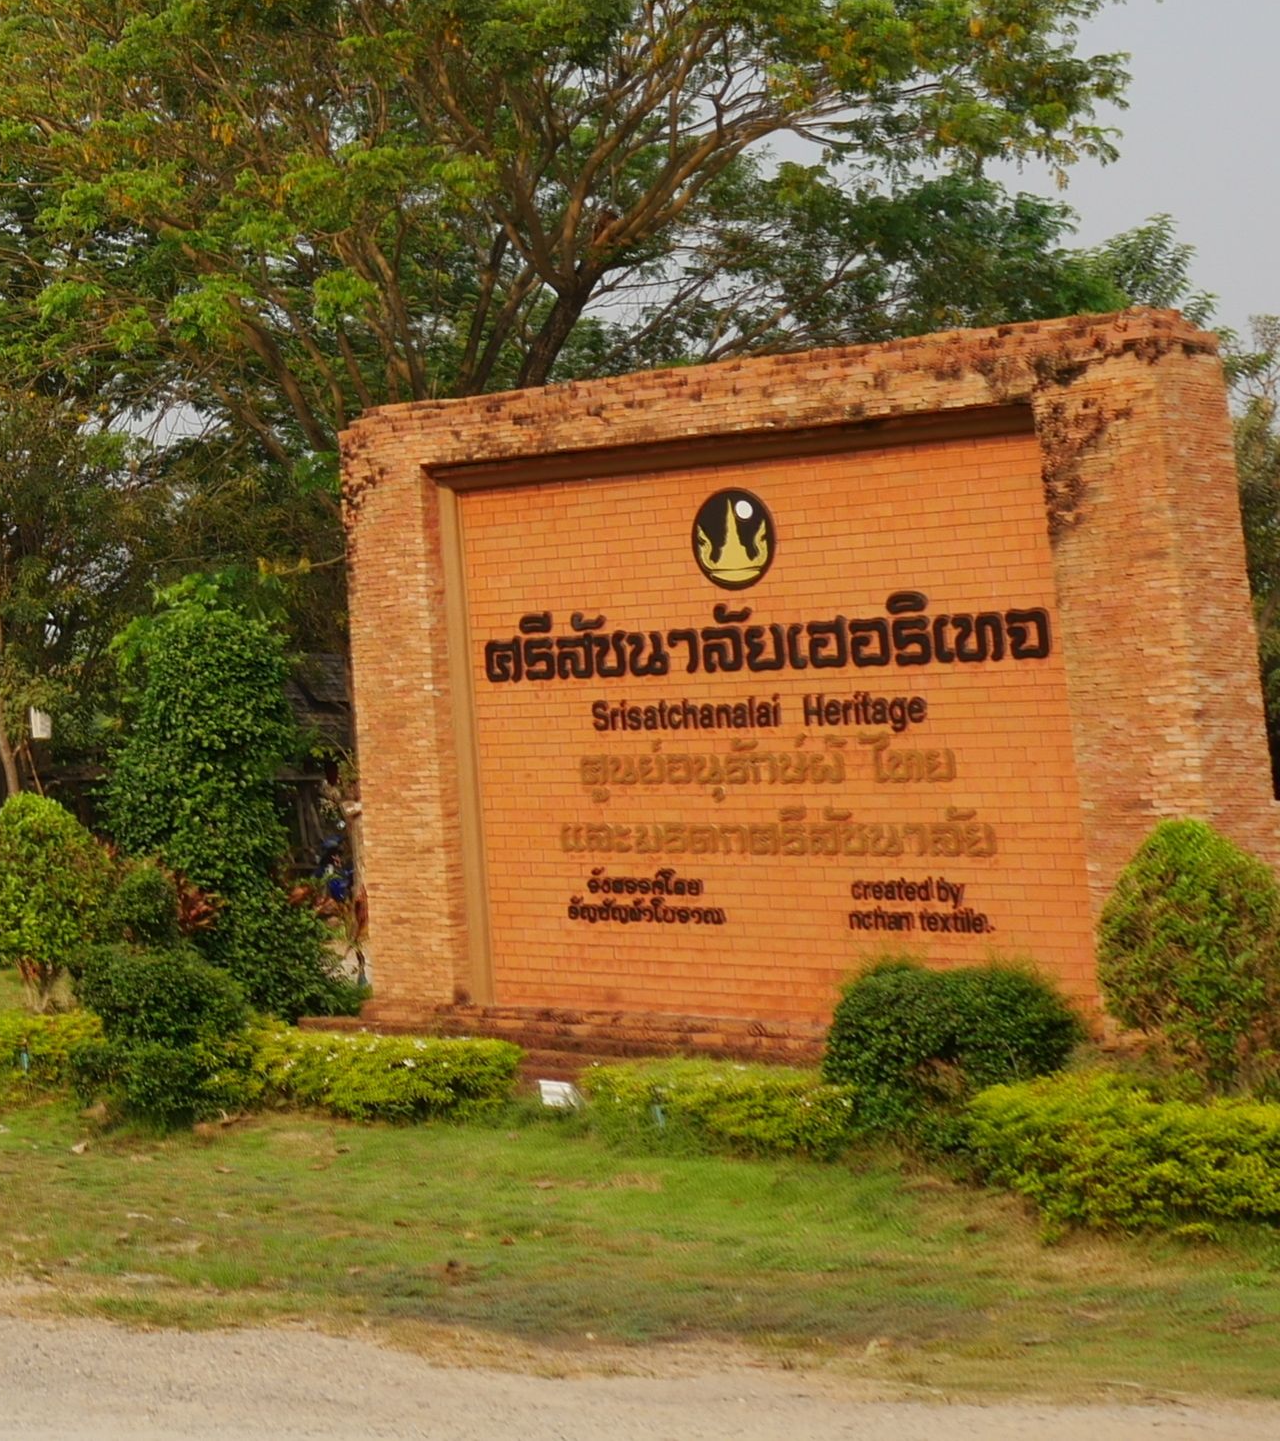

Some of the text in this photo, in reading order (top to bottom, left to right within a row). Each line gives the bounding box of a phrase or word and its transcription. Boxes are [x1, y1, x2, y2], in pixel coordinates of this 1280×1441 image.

[484, 590, 1053, 683] ศรีสัชนาลัยเฮอริเทจ
[591, 690, 928, 733] Srisatchanalai Heritage
[560, 805, 997, 858] และมรดกศรีสัชนาลัย
[851, 875, 965, 909] created by
[849, 905, 916, 932] nchan
